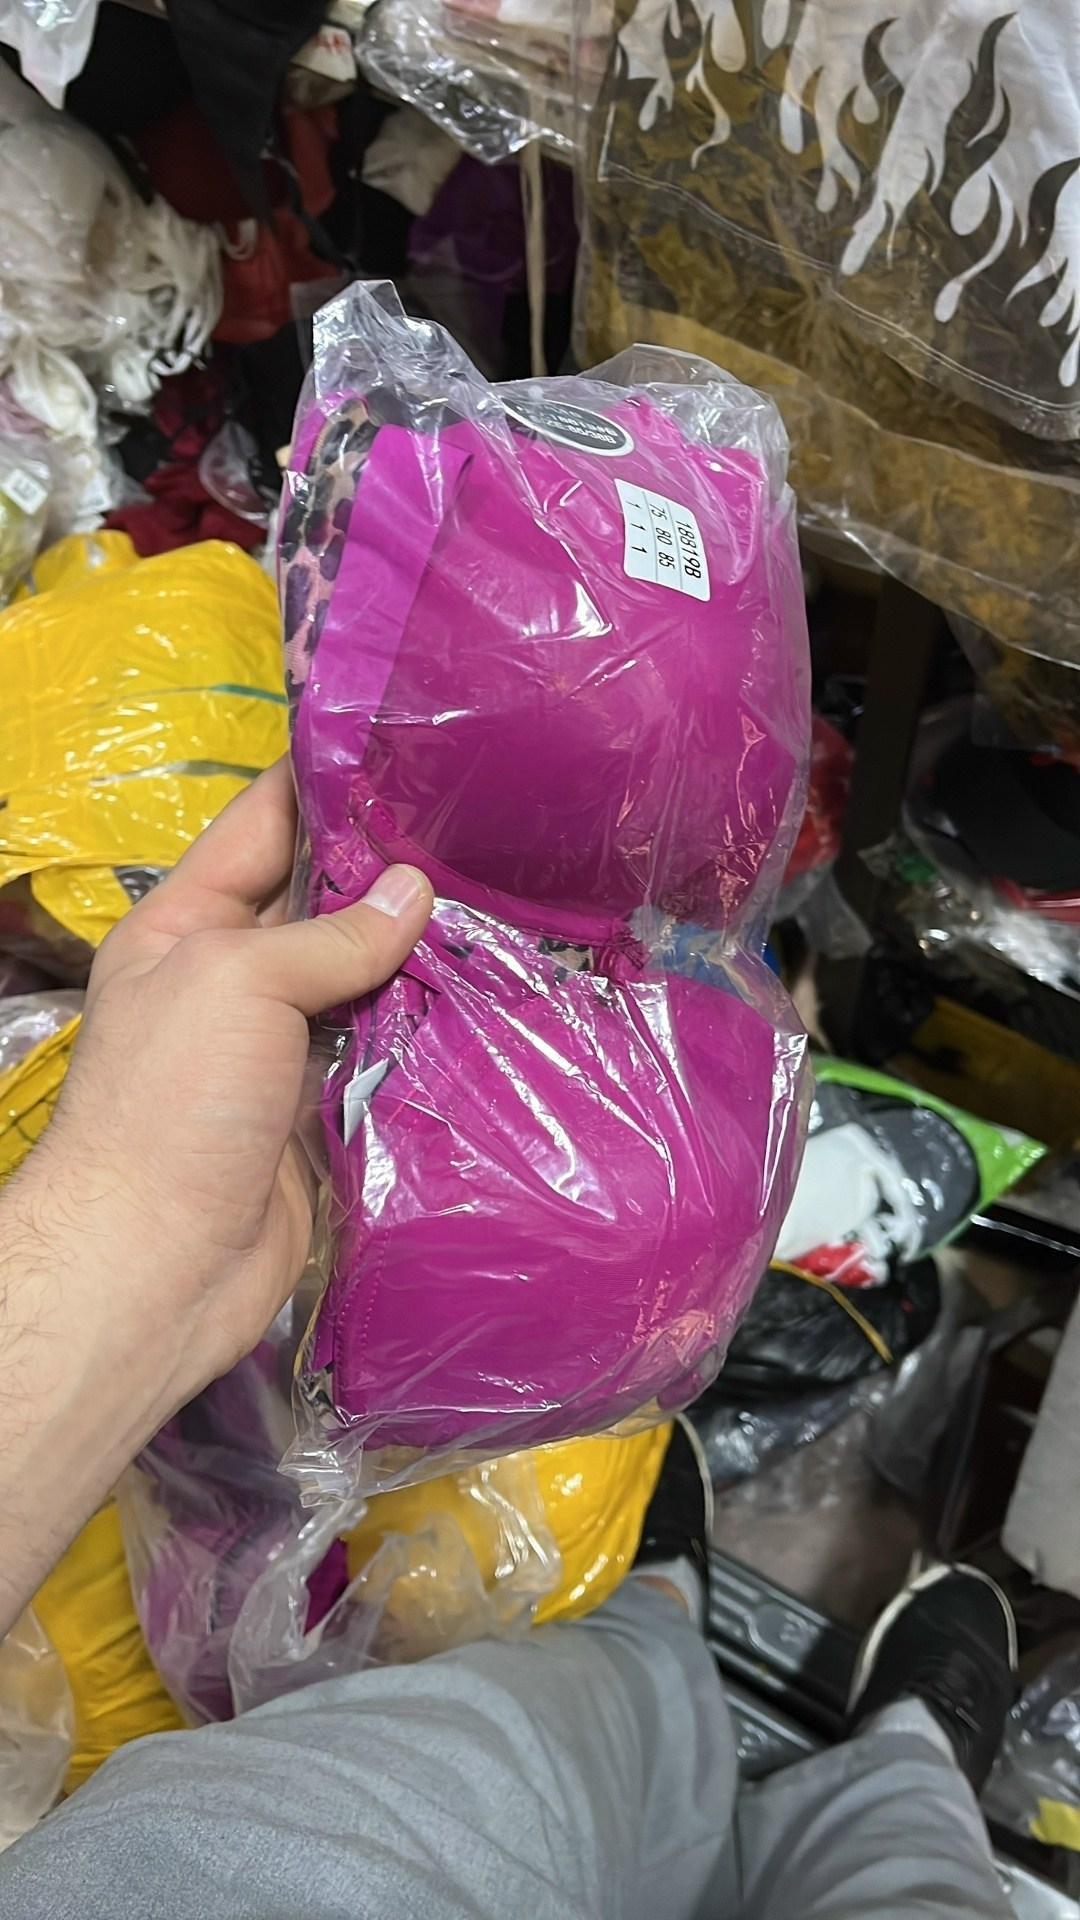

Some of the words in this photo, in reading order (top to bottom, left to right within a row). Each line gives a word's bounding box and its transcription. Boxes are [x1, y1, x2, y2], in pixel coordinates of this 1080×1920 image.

[625, 501, 641, 509] 1
[649, 503, 668, 520] 75
[630, 522, 647, 531] 1
[655, 527, 673, 546] 80
[631, 545, 648, 554] 1
[675, 520, 702, 579] 18819B
[658, 551, 676, 570] 85
